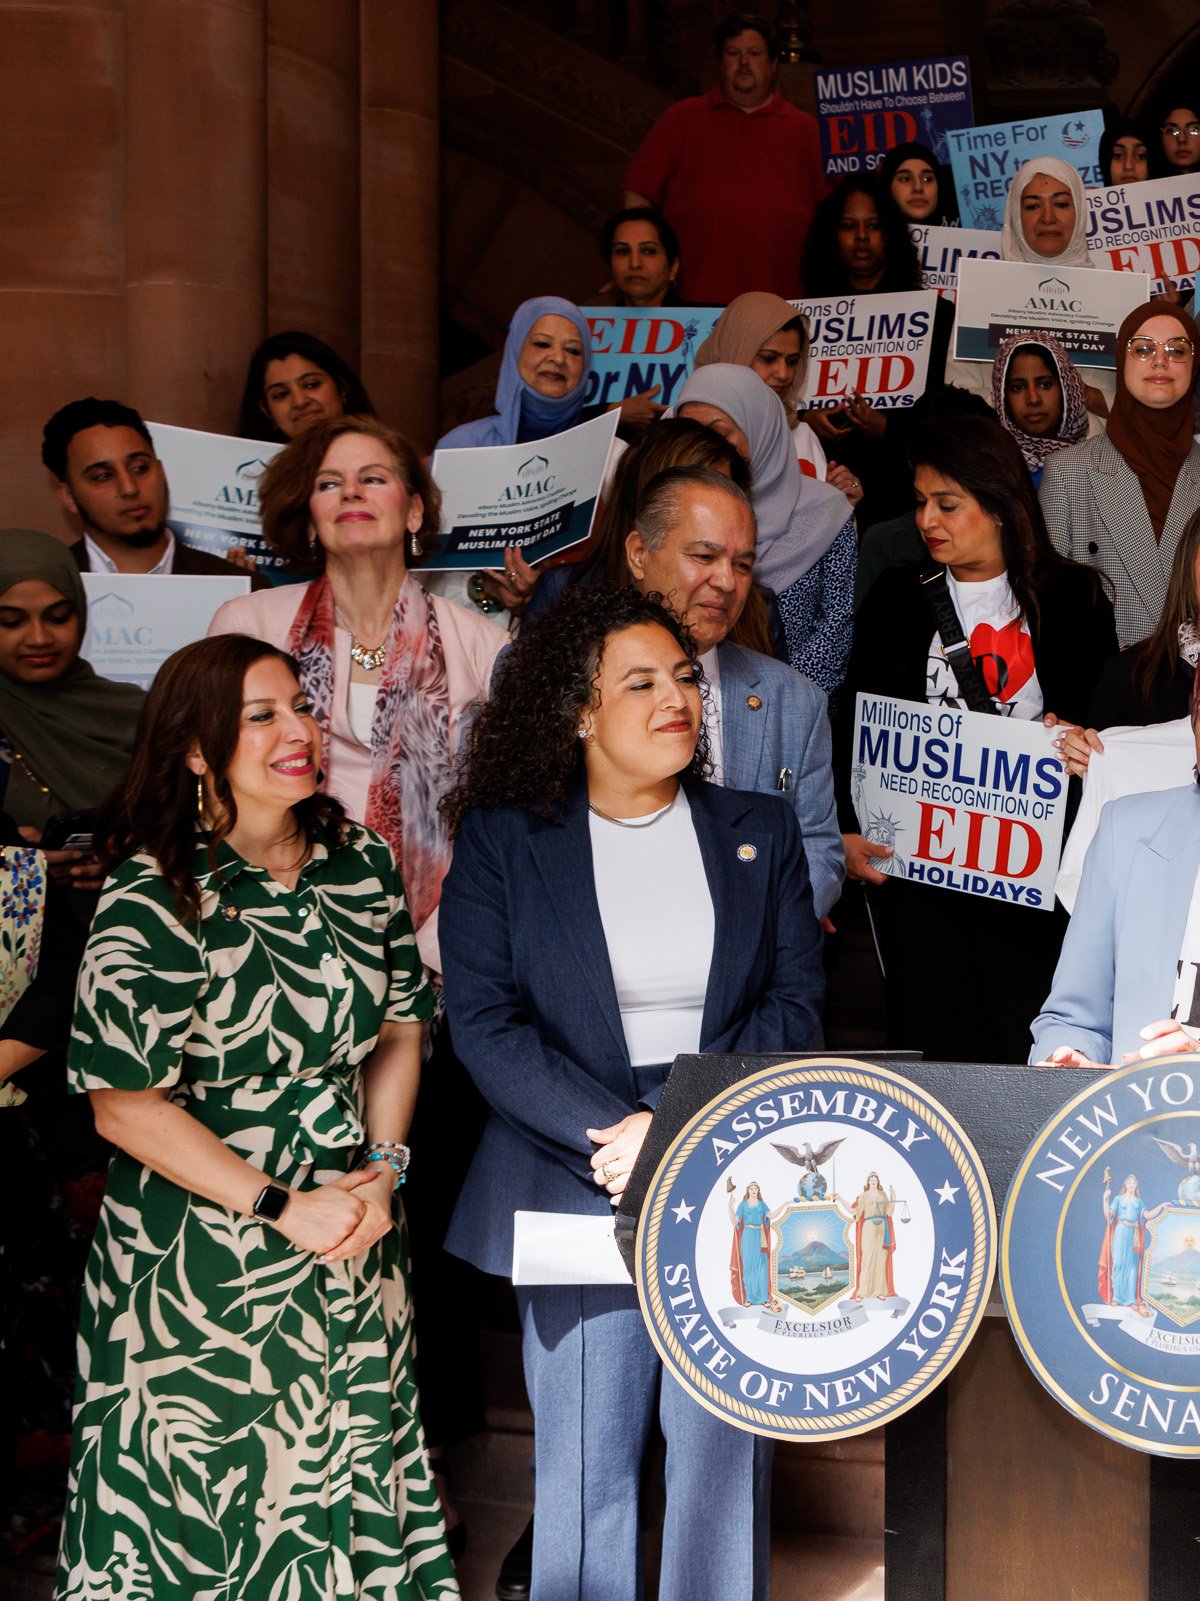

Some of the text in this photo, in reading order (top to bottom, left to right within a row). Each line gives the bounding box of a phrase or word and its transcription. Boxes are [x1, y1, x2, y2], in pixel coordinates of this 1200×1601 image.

[816, 61, 967, 100] MUSLIM KIDS
[819, 91, 966, 115] Shouldn't Have To Choose Between
[824, 111, 917, 155] EID
[951, 124, 1048, 152] Time For
[826, 156, 860, 174] AND
[969, 150, 1009, 180] NY
[1107, 188, 1125, 206] Of
[911, 229, 929, 244] Of
[1105, 225, 1191, 248] RECOGNITION
[836, 299, 856, 316] Of
[1025, 297, 1082, 313] AMAC
[586, 318, 685, 354] EID
[821, 342, 904, 358] RECOGNITION
[907, 339, 924, 351] OF
[1066, 332, 1100, 341] STATE
[1083, 343, 1106, 351] DAY
[623, 363, 687, 405] NY
[811, 355, 915, 398] EID
[498, 475, 556, 501] AMAC
[457, 522, 562, 551] MUSLIM LOBBY DAY
[468, 511, 561, 538] NEW YORK STATE
[90, 627, 152, 646] MAC
[861, 700, 932, 734] Millions
[937, 713, 963, 739] Of
[859, 725, 1063, 801] MUSLIMS
[880, 772, 1055, 820] NEED RECOGNITION OF
[911, 801, 1043, 880] EID
[908, 862, 1043, 906] HOLIDAYS
[711, 1089, 930, 1166] ASSEMBLY
[1035, 1094, 1119, 1194] NEW
[664, 1247, 968, 1412] STATE OF NEW YORK
[774, 1316, 852, 1332] EXCELSIOR
